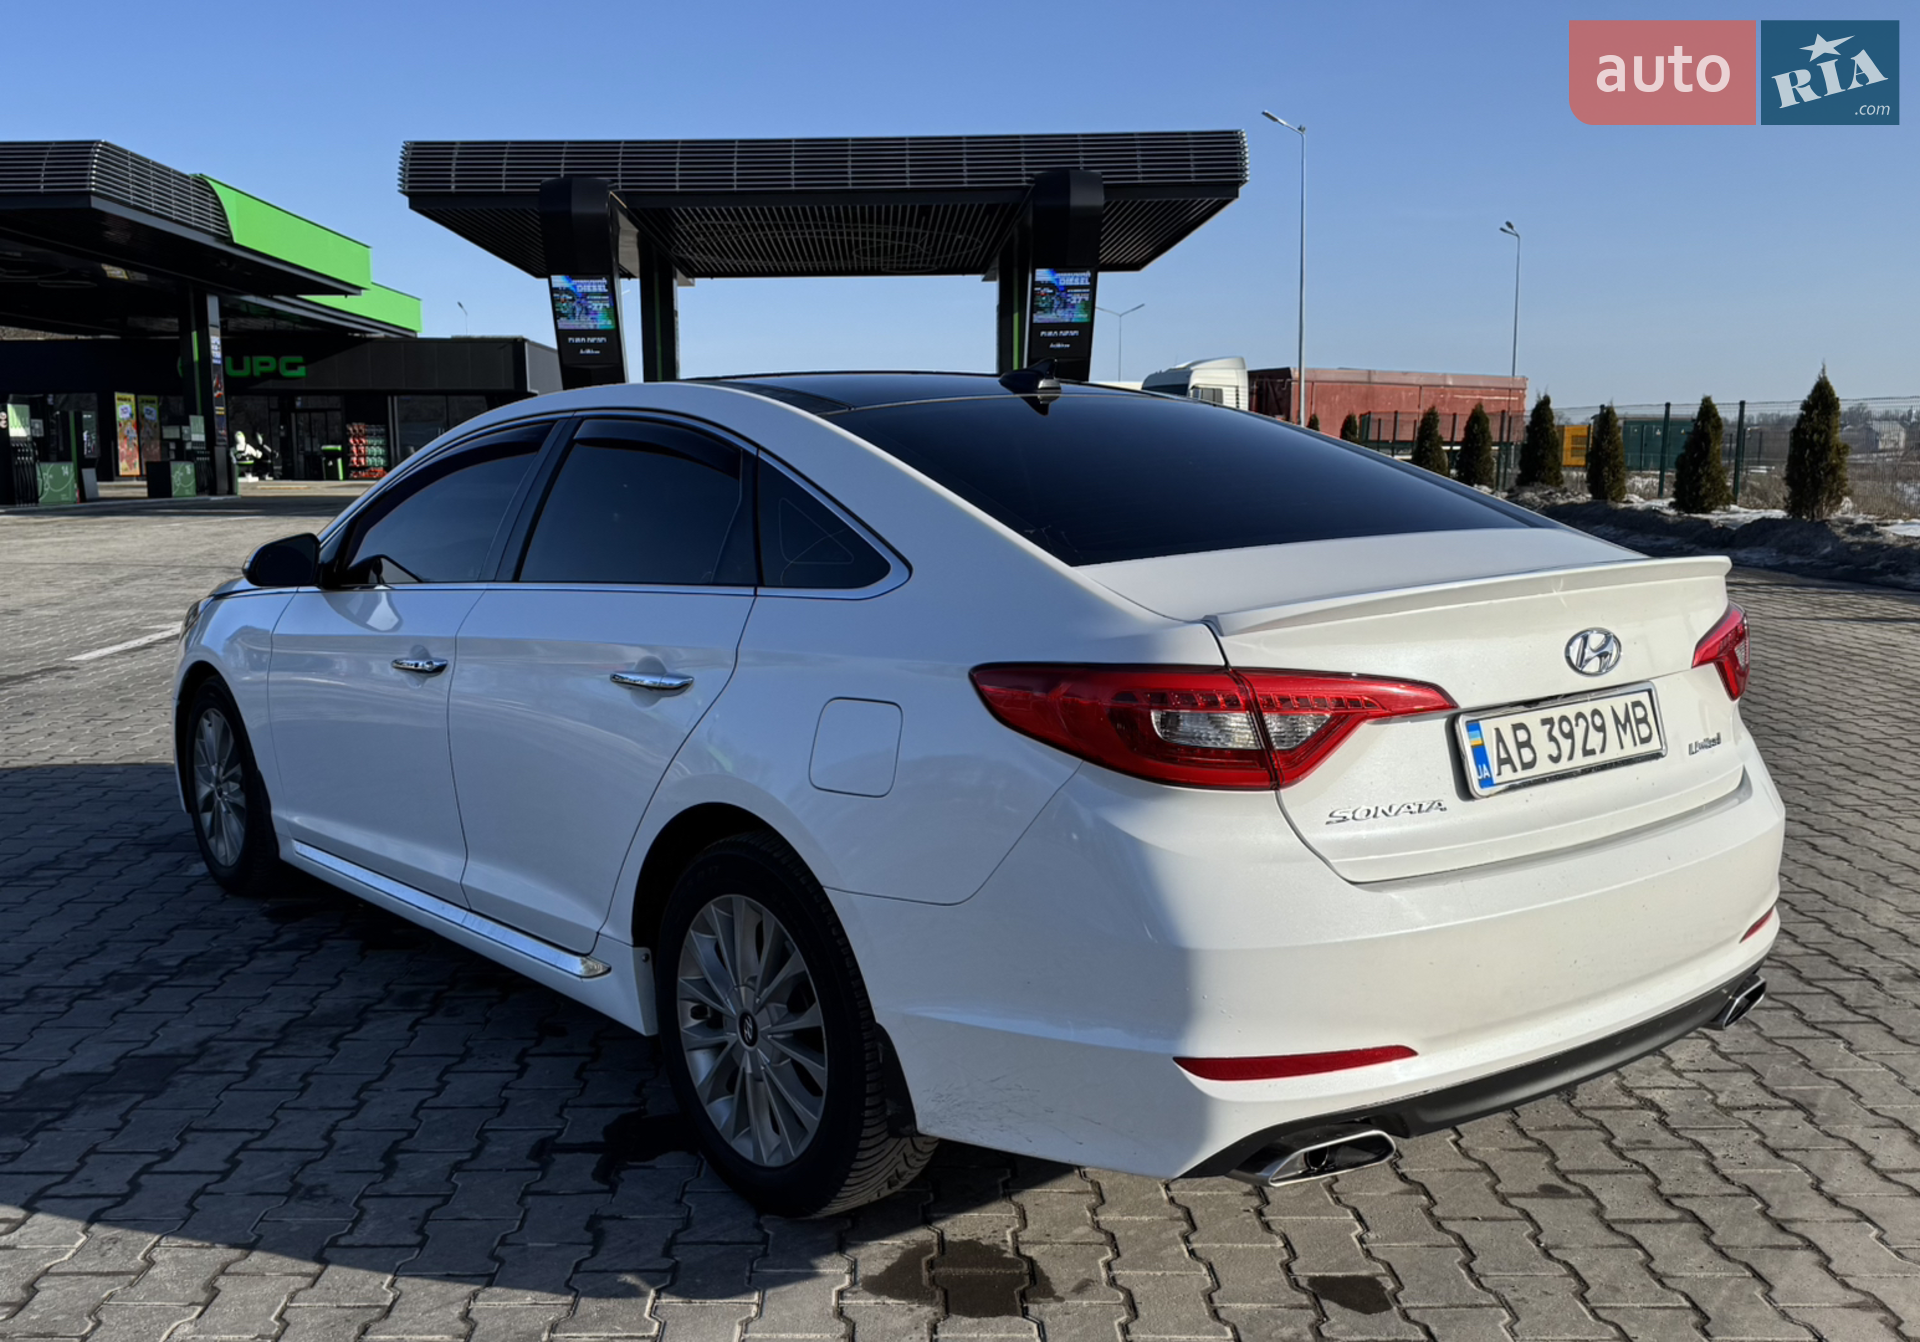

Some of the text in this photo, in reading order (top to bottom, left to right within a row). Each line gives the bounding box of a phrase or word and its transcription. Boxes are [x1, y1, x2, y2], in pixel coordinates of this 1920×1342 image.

[225, 356, 307, 377] UPG
[1493, 700, 1653, 776] AB 3929 MB
[1325, 799, 1448, 825] SONATA
